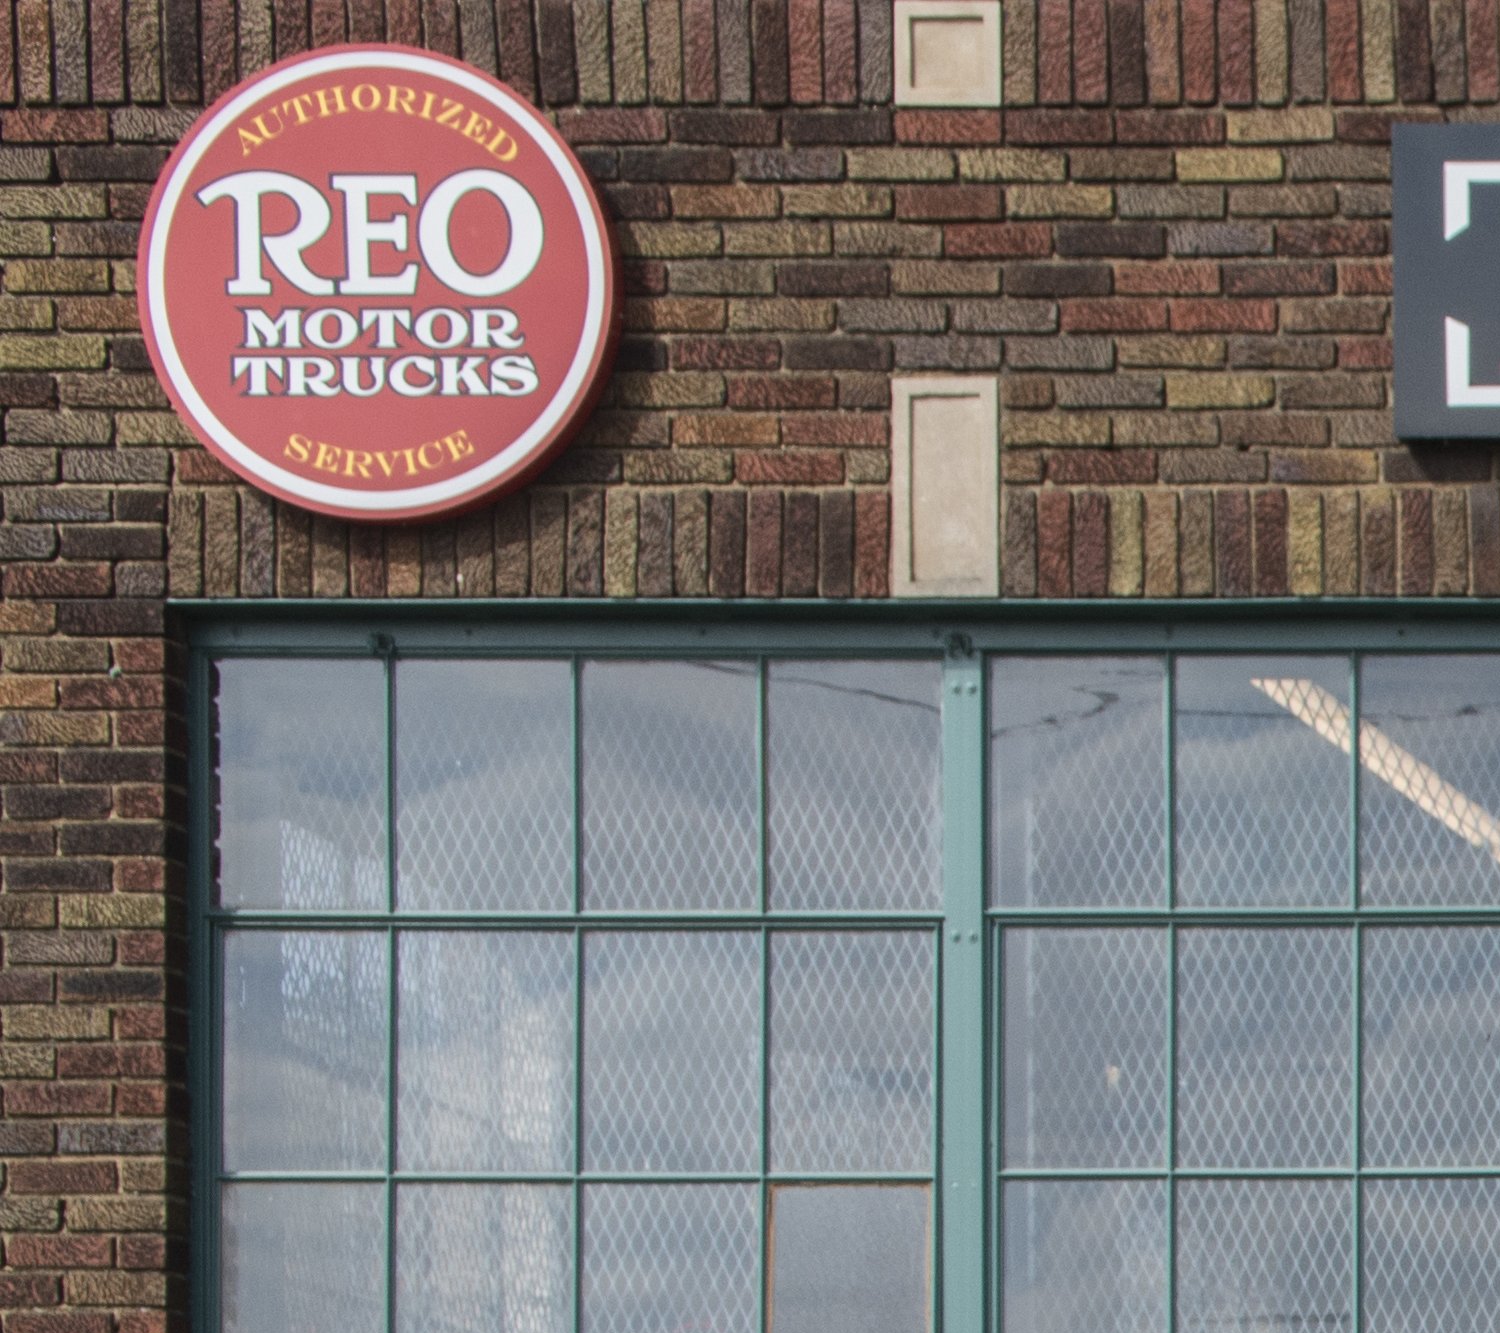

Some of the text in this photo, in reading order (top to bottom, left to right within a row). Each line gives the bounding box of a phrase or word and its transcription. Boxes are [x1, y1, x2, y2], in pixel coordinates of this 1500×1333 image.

[237, 82, 520, 163] AUTHORIZED
[195, 167, 545, 297] REO
[239, 306, 525, 350] MOTOR
[232, 354, 540, 398] TRUCKS
[282, 429, 475, 480] SERVICE
